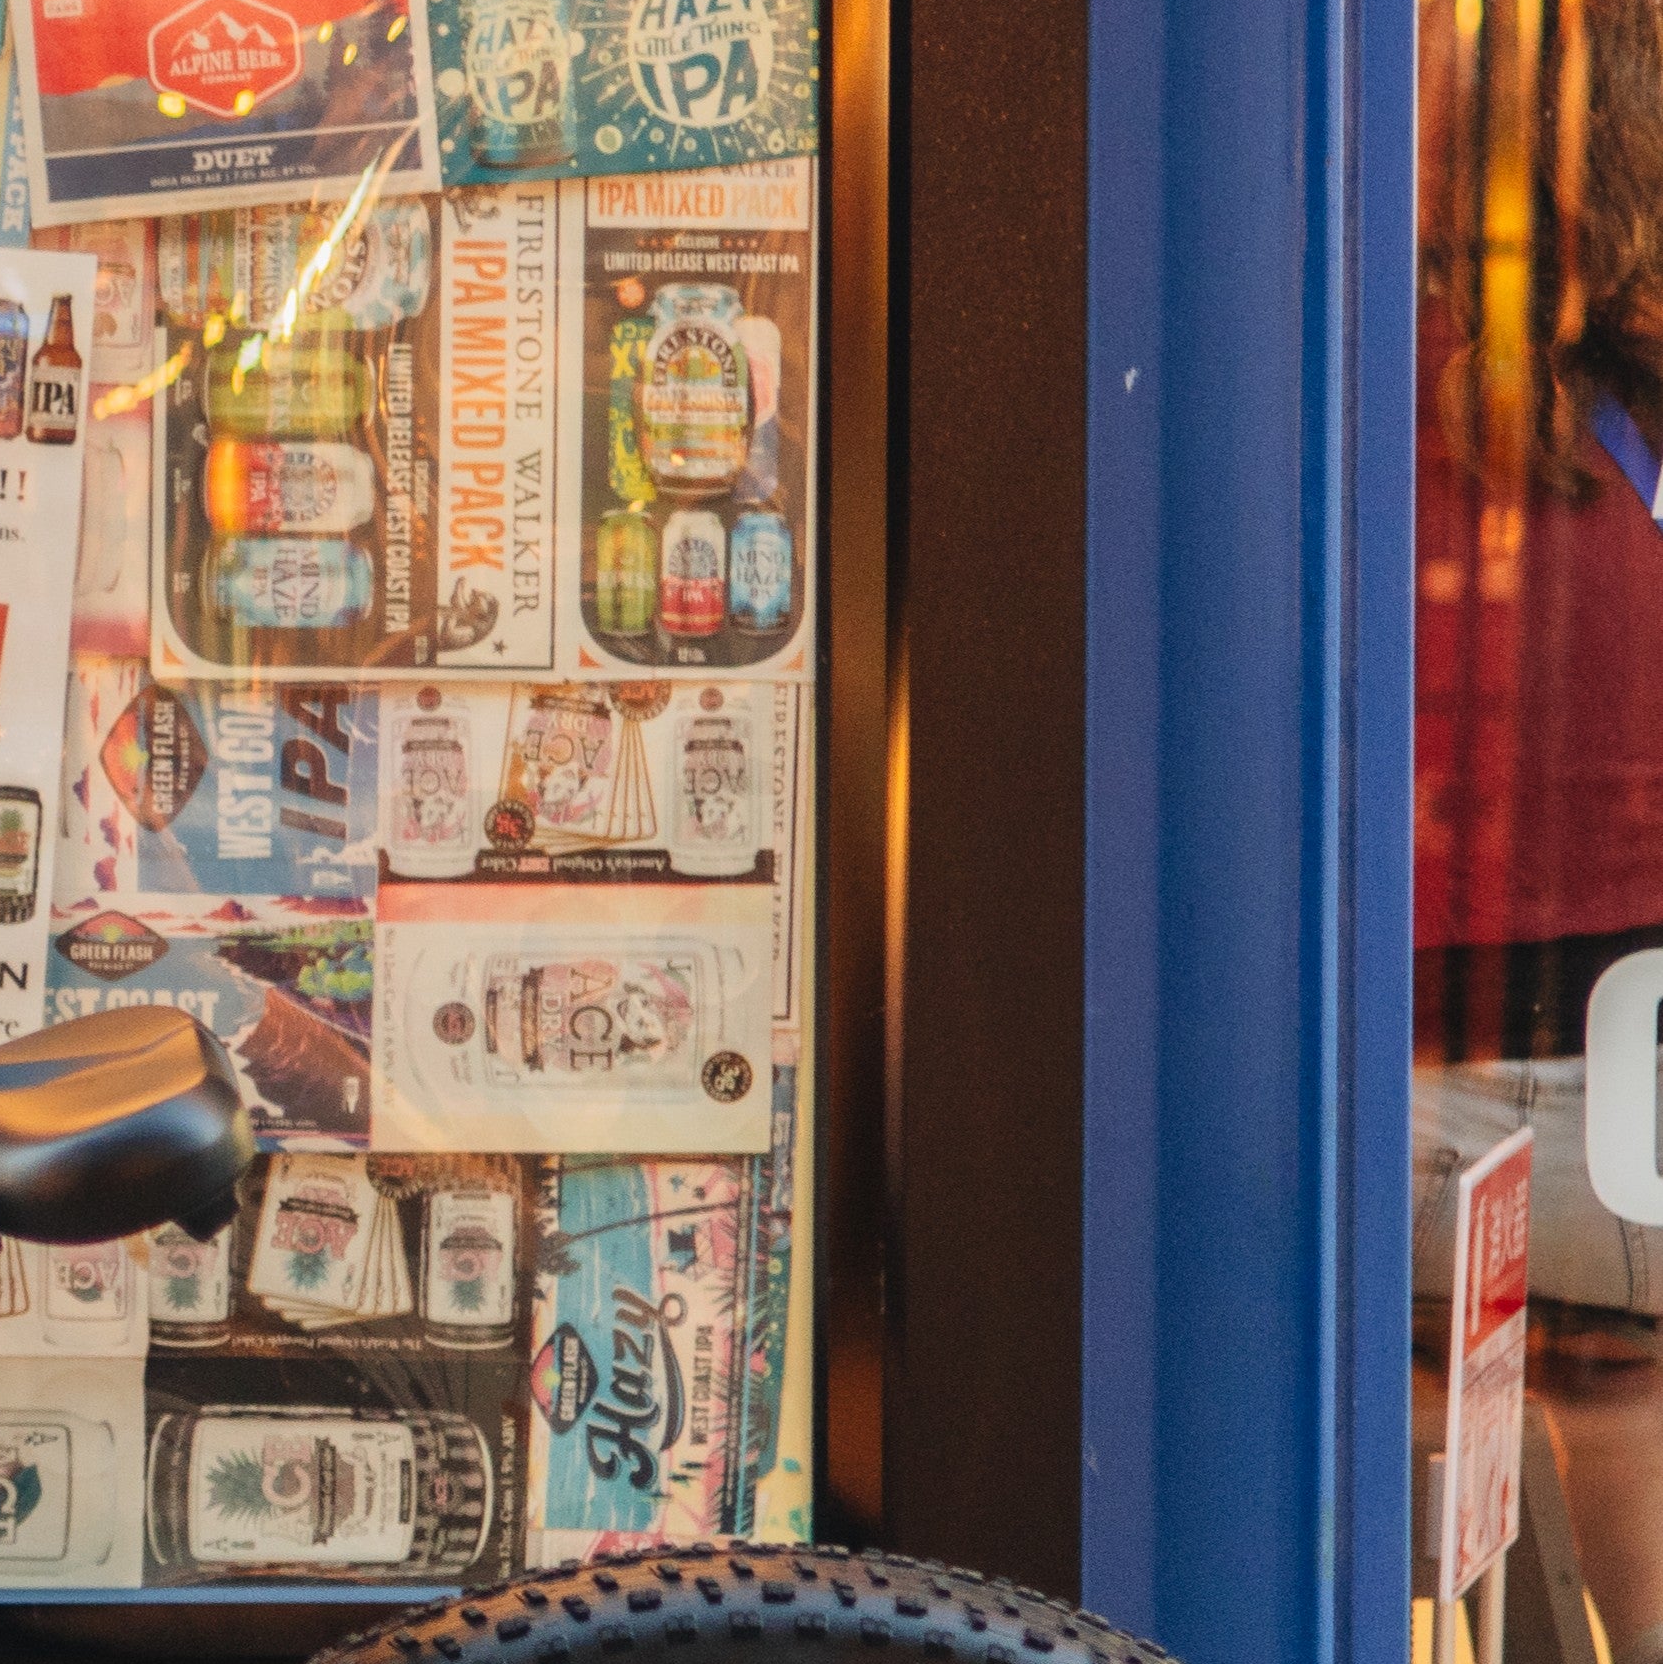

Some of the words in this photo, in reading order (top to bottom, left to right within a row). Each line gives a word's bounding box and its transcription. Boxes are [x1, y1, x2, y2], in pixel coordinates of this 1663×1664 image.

[475, 16, 556, 54] HAZY
[634, 34, 692, 57] LITTLE
[699, 19, 762, 44] THING
[170, 52, 233, 77] ALPINE
[634, 40, 759, 118] IPA
[476, 60, 560, 117] IPA
[193, 145, 277, 171] DUET
[598, 182, 639, 216] IPA
[644, 182, 724, 217] MIXED
[731, 183, 798, 219] PACK
[452, 239, 507, 306] IPA
[604, 253, 652, 272] LIMITED
[654, 253, 704, 272] RELEASE
[706, 254, 736, 272] WEST
[740, 255, 777, 272] COAST
[779, 256, 799, 272] IPA
[514, 193, 545, 421] FIRESTONE
[387, 343, 413, 415] LIMITED
[652, 326, 738, 388] FIRESTONE
[32, 380, 75, 415] IPA
[450, 316, 506, 450] MIXED
[386, 417, 412, 492] RELEASE
[249, 471, 267, 503] IPA
[386, 496, 411, 543] WEST
[449, 462, 506, 572] PACK
[511, 450, 542, 617] WALKER
[273, 547, 298, 619] HAZE
[300, 547, 321, 620] MIND
[385, 545, 410, 602] COAST
[385, 604, 409, 633] IPA
[153, 701, 174, 755] FLASH
[545, 712, 588, 734] DRY
[280, 684, 349, 841] IPA
[522, 728, 605, 771] ACE
[152, 758, 174, 814] GREEN
[401, 768, 462, 796] ACE
[682, 767, 745, 795] ACE
[216, 768, 272, 859] WEST
[481, 856, 517, 872] Cider
[553, 854, 603, 872] Original
[605, 855, 667, 872] America's
[70, 944, 111, 960] GREEN
[113, 944, 153, 961] FLASH
[539, 992, 564, 1051] DRY
[568, 968, 614, 1073] ACE
[271, 1212, 357, 1261] ACE
[52, 1257, 120, 1290] ACE
[562, 1336, 579, 1377] FLASH
[693, 1325, 713, 1352] IPA
[559, 1381, 574, 1421] GREEN
[585, 1287, 686, 1490] Hazy
[691, 1355, 712, 1403] COAST
[690, 1406, 709, 1446] WEST
[260, 1434, 312, 1545] ACE
